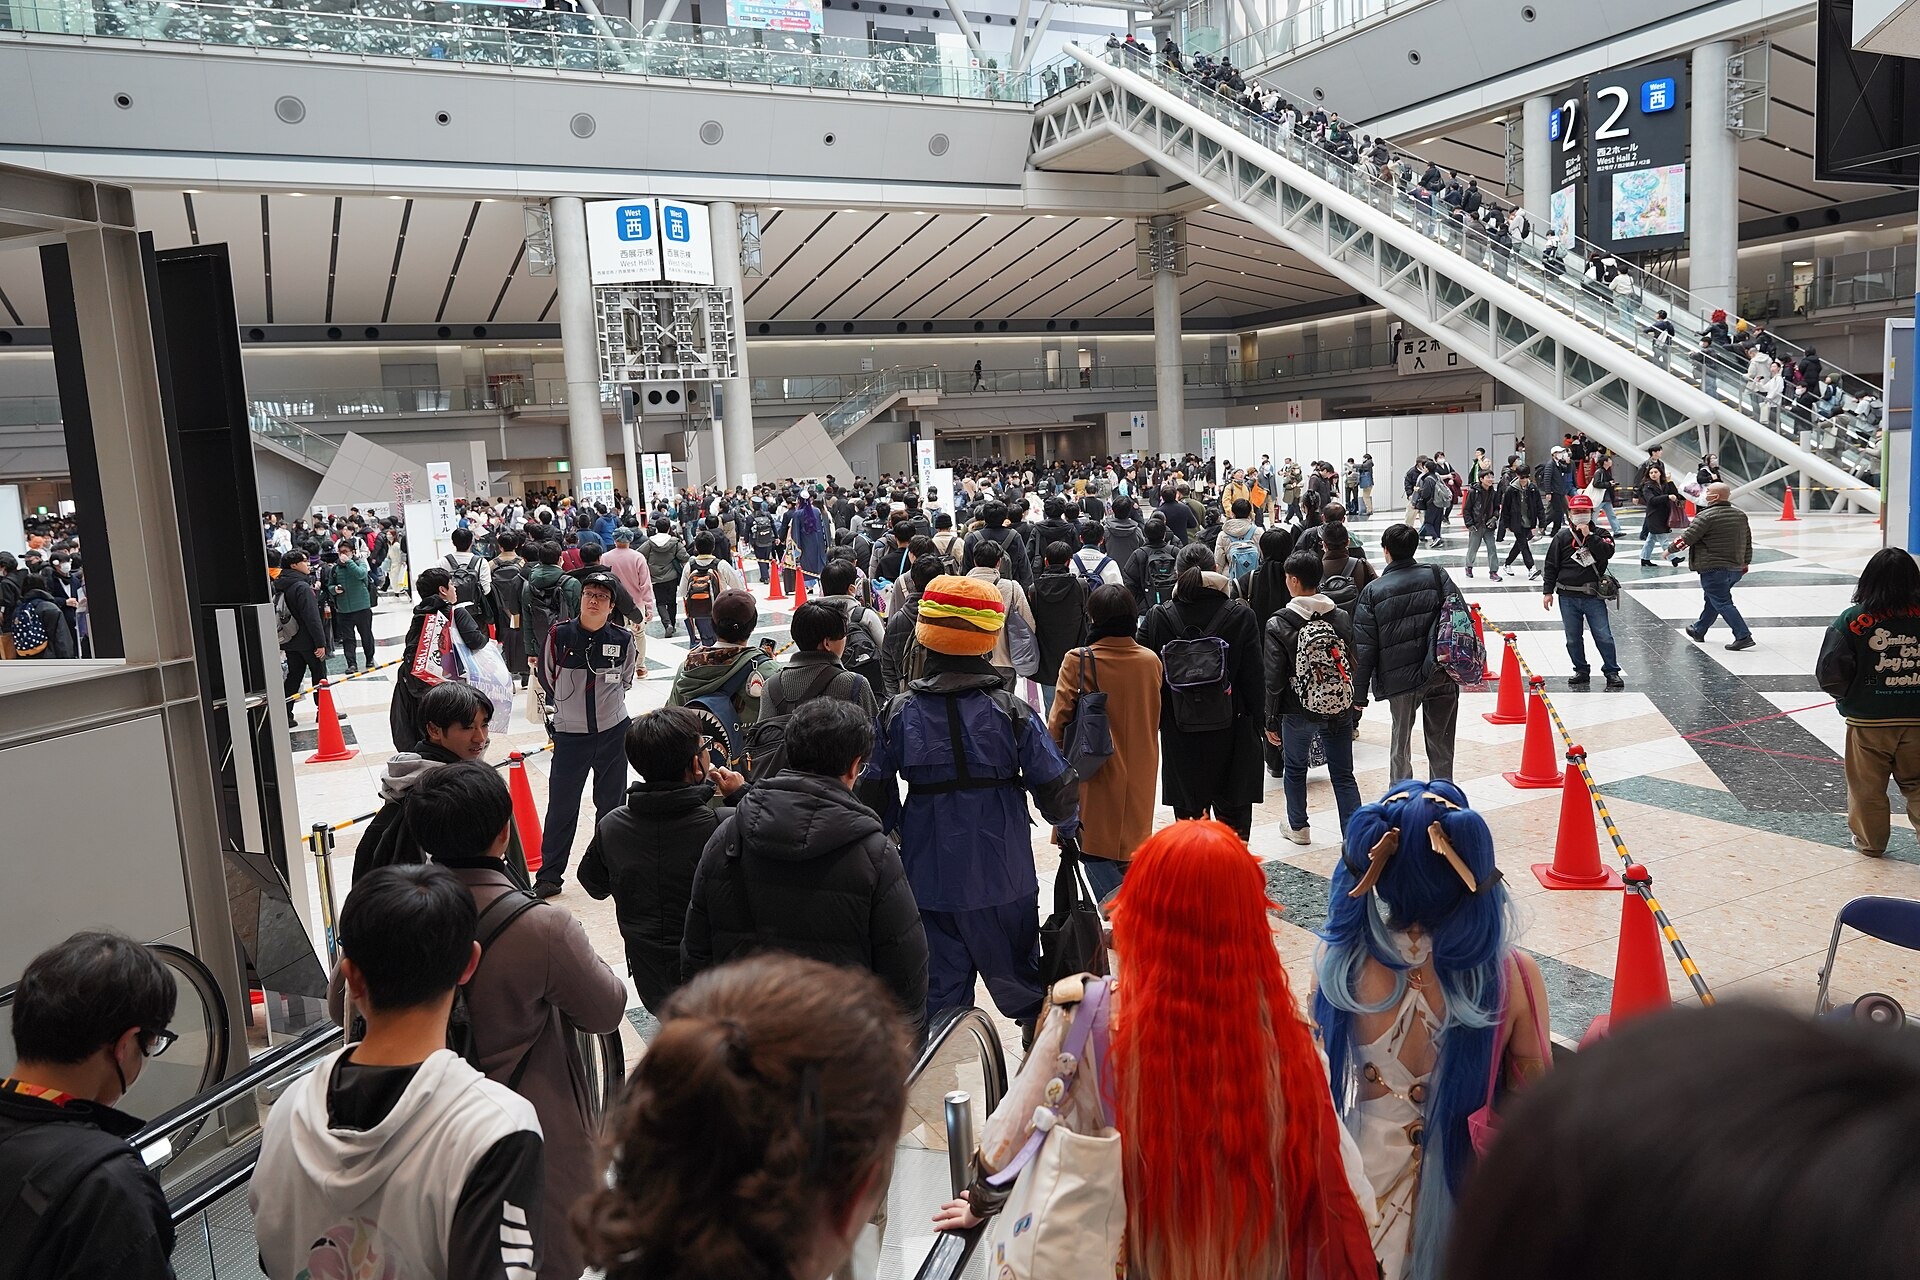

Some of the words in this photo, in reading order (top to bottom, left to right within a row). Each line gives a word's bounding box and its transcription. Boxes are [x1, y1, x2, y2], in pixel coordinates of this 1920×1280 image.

[1650, 82, 1666, 91] West
[1650, 90, 1666, 109] 西
[1595, 86, 1630, 140] 2
[1562, 99, 1576, 152] 2
[1596, 143, 1639, 157] 西2ホール
[1597, 156, 1615, 166] West
[1616, 153, 1631, 163] Hall
[1631, 153, 1637, 161] 2
[625, 209, 641, 217] West
[669, 210, 683, 218] West
[625, 218, 643, 238] 西
[671, 219, 684, 239] 西
[620, 248, 654, 259] 西展示棟
[438, 499, 450, 533] 西1ホール
[1868, 628, 1917, 651] Smiles
[1875, 652, 1901, 672] joy
[1902, 658, 1915, 668] to
